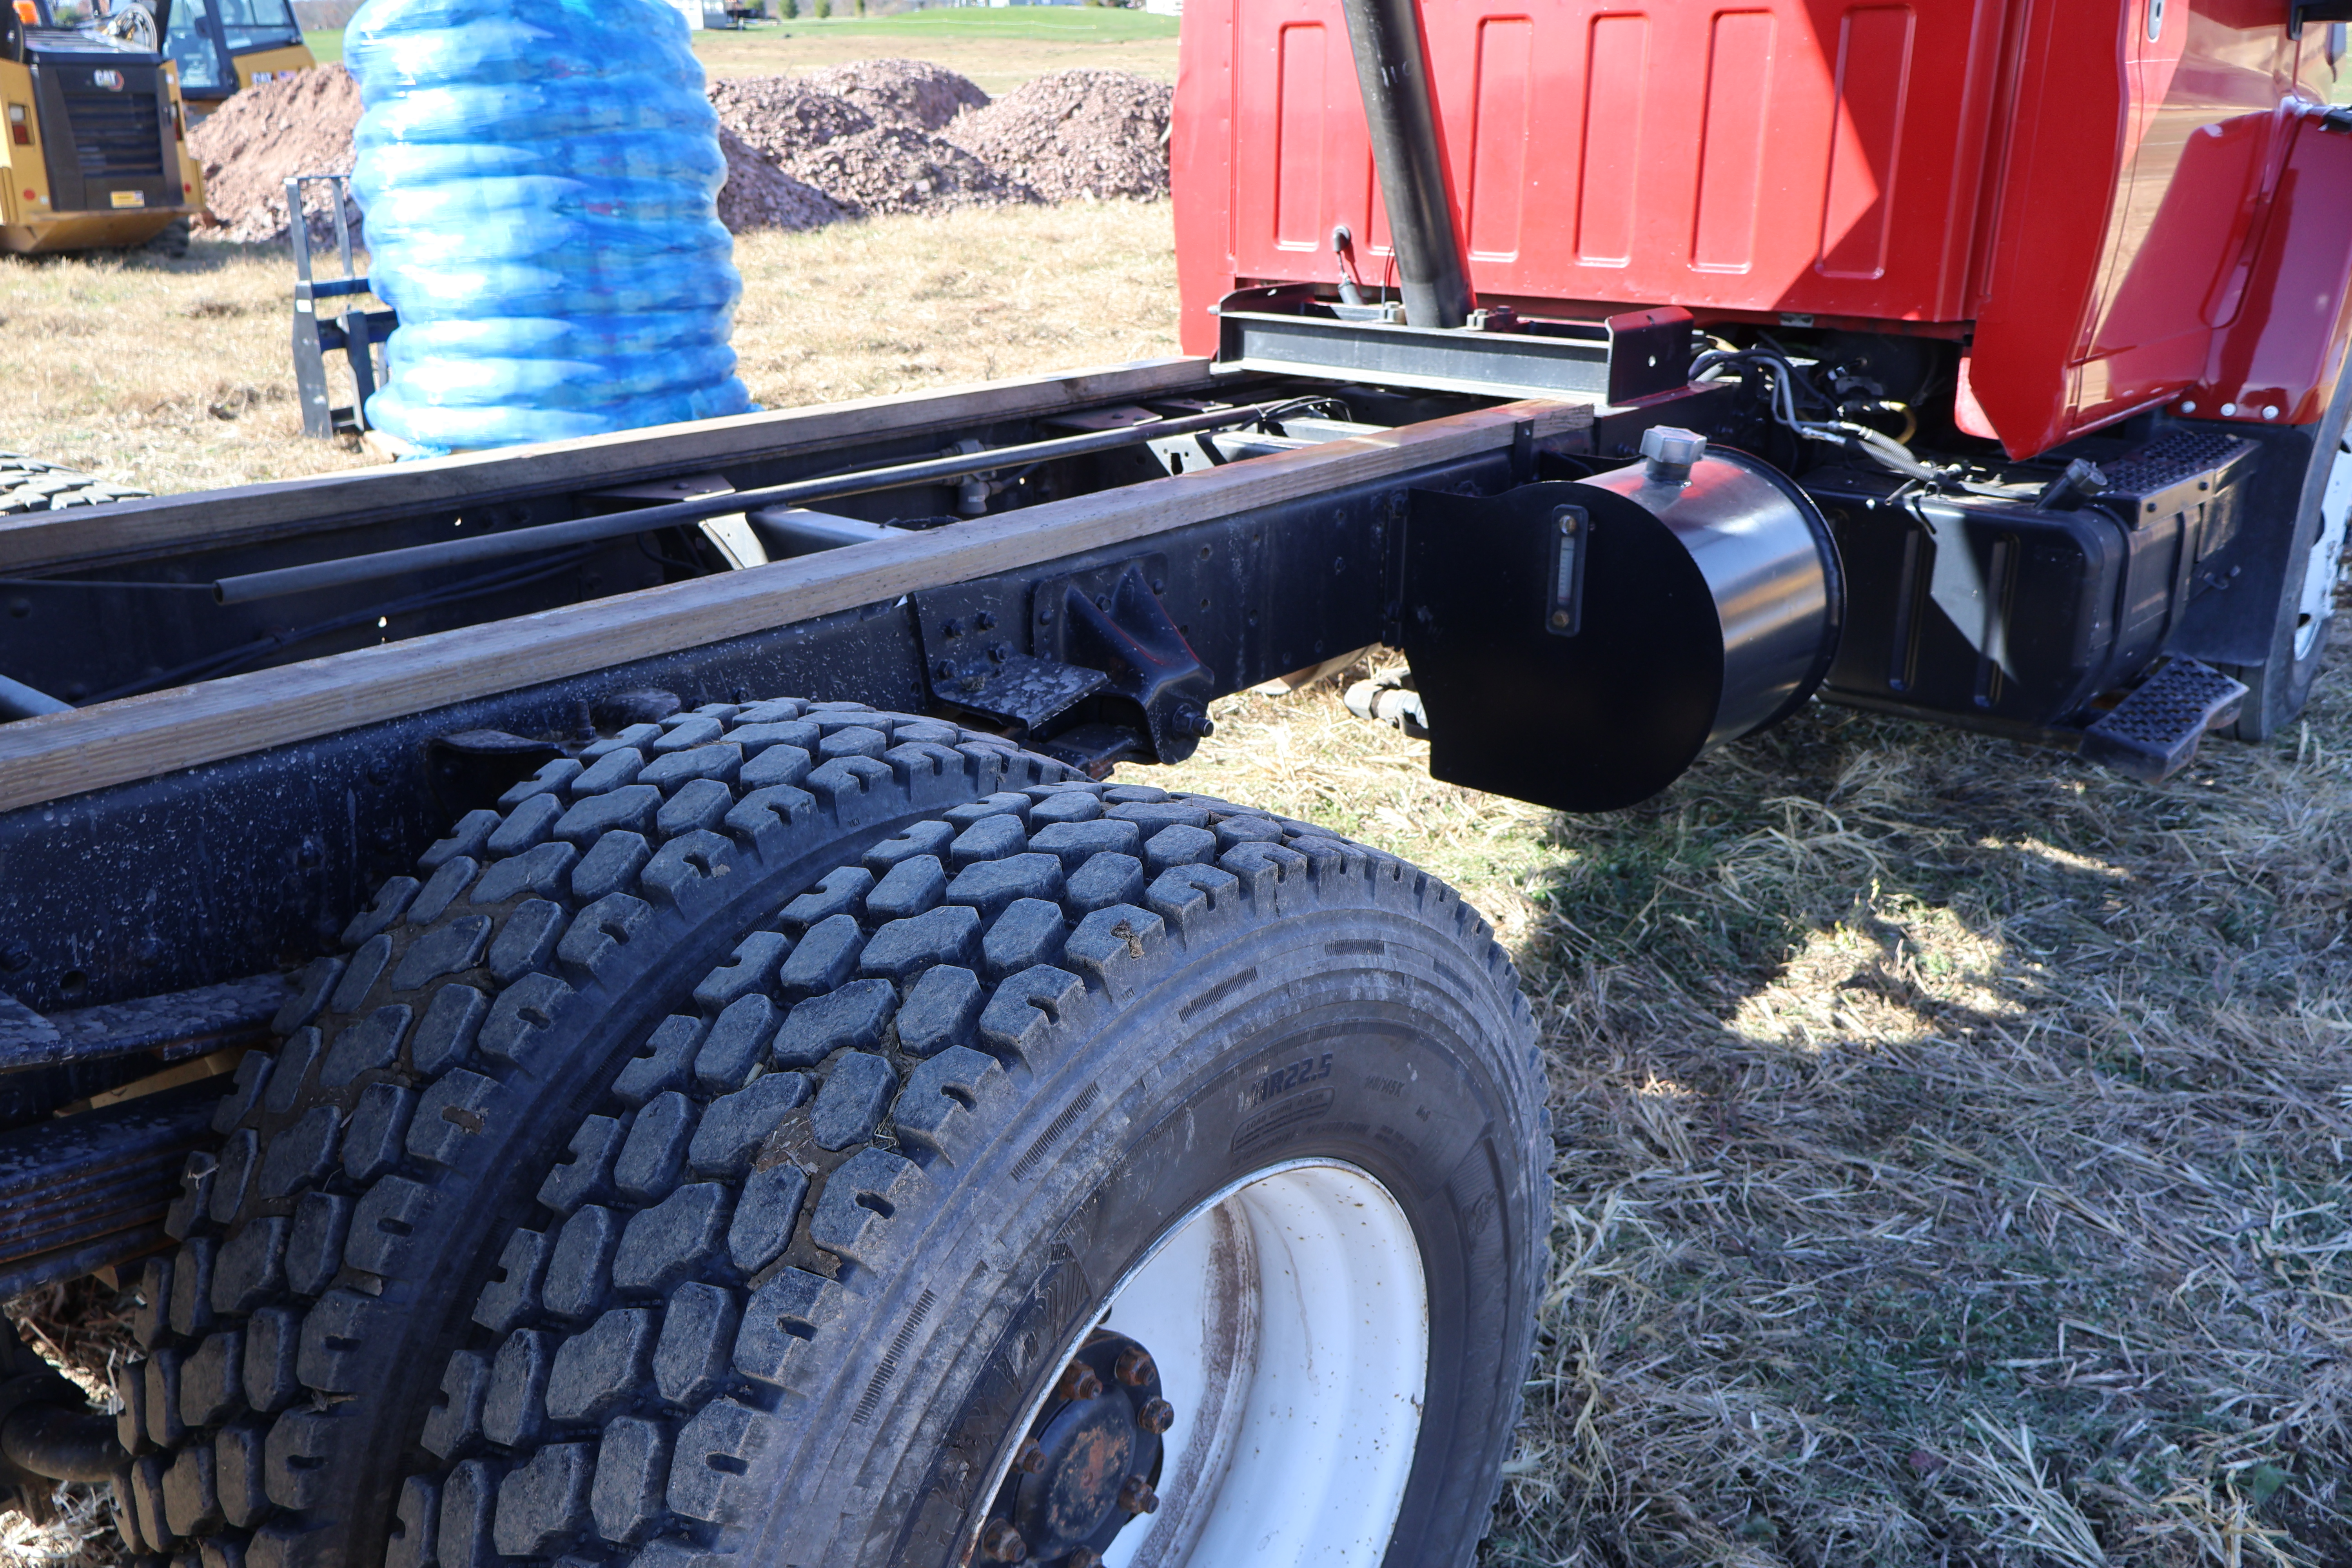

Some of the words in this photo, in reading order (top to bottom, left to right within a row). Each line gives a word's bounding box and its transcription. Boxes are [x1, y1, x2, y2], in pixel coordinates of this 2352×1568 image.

[94, 69, 116, 87] CAT
[252, 72, 273, 83] CAT
[1250, 1053, 1332, 1107] 11R22.5
[1247, 1114, 1267, 1131] LOAD
